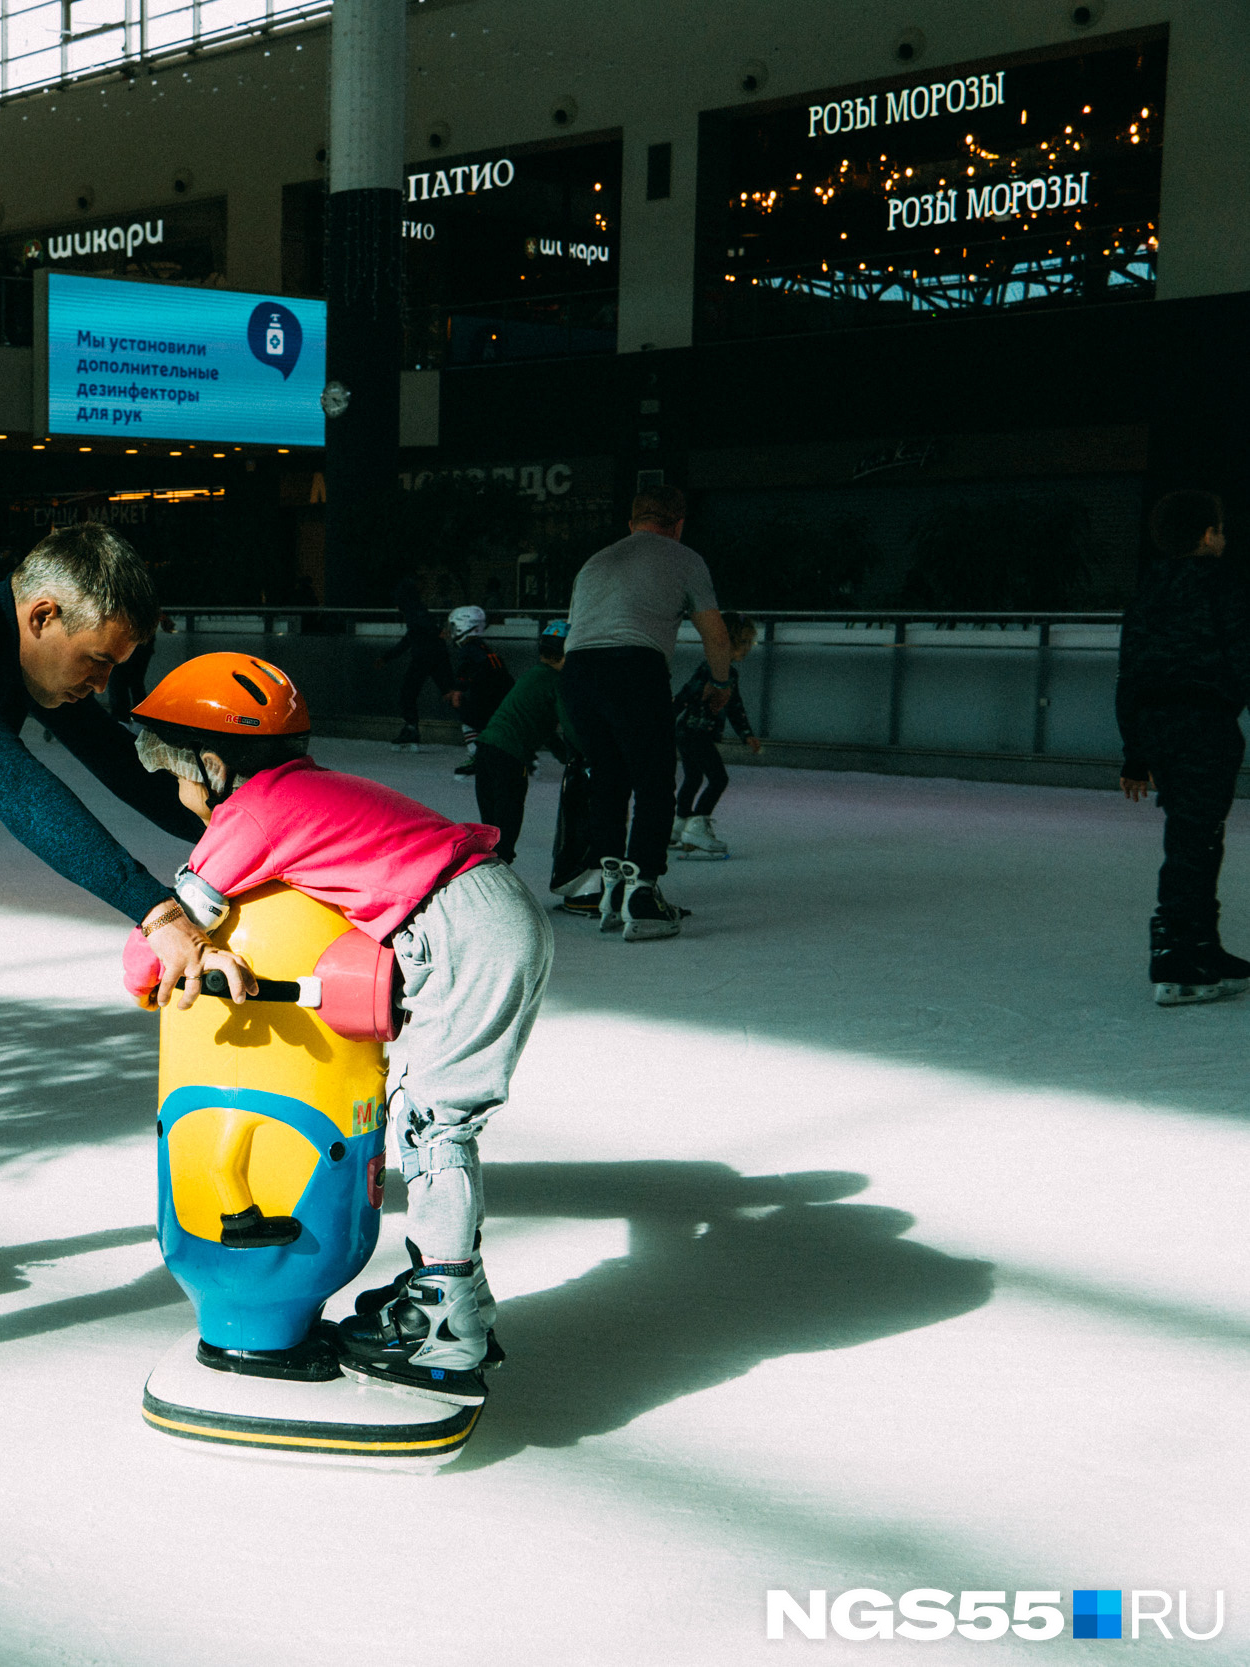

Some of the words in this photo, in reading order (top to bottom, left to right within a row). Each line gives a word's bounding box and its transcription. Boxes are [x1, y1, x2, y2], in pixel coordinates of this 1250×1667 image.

[808, 95, 878, 137] РОЗЫ
[885, 71, 1005, 125] МОРОЗЫ
[407, 158, 515, 202] ПАТИО
[887, 189, 957, 231] РОЗЫ
[966, 171, 1090, 220] МОРОЗЫ
[48, 219, 164, 258] шикари
[77, 330, 104, 350] Мы
[109, 336, 206, 357] установили
[77, 359, 219, 381] дополнительные
[77, 382, 200, 406] дезинфекторы
[77, 406, 109, 423] для
[113, 409, 143, 426] рук
